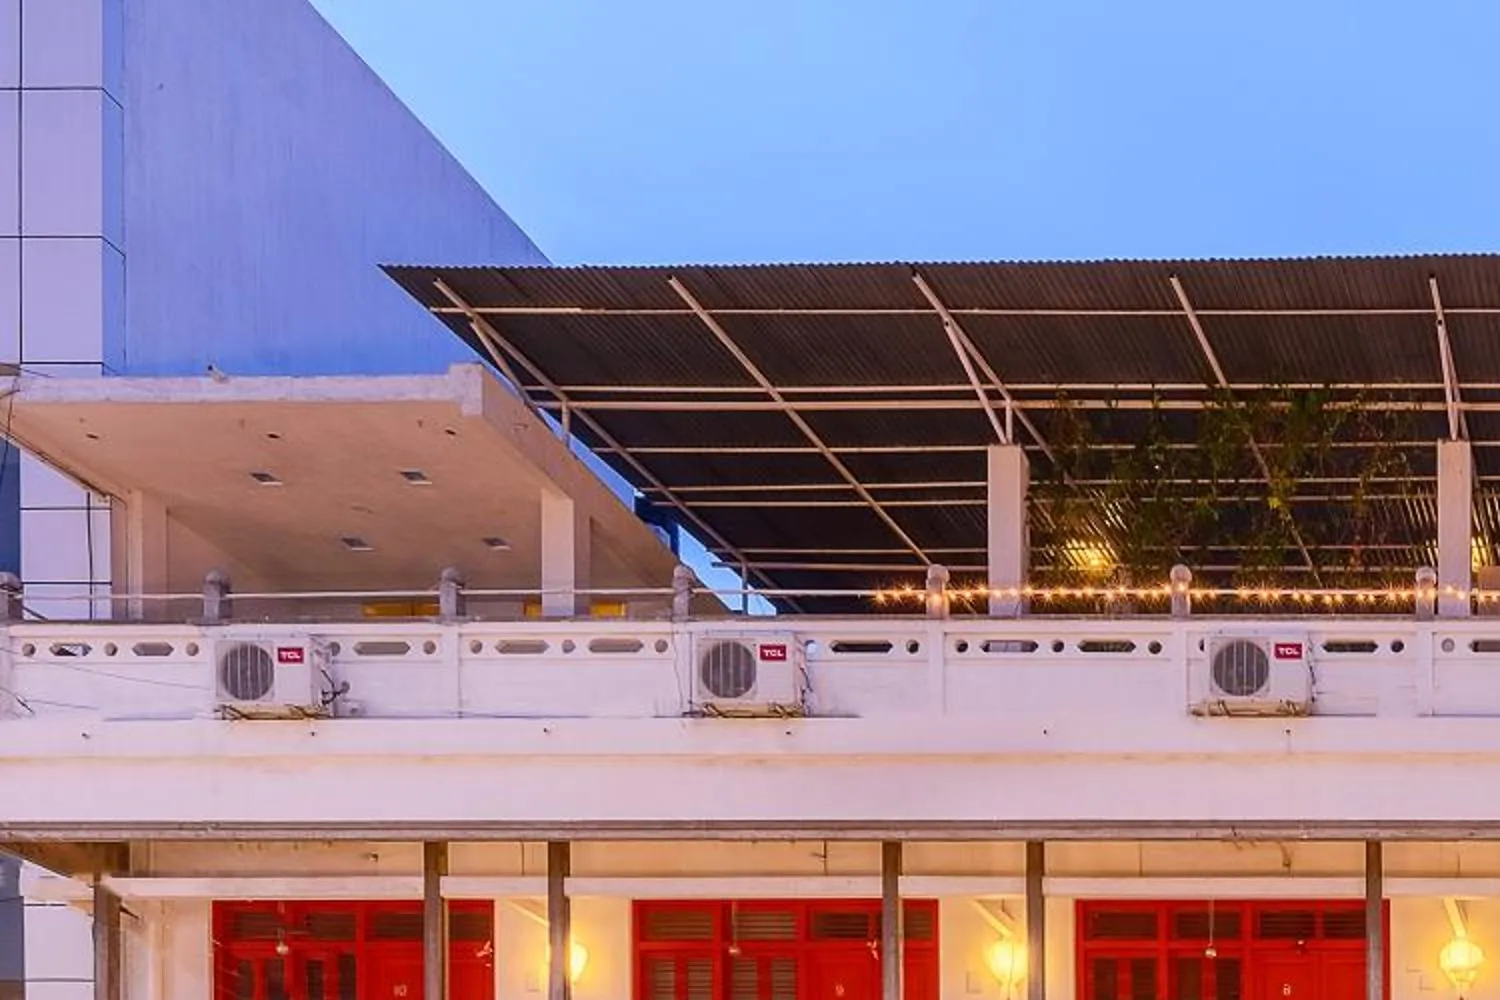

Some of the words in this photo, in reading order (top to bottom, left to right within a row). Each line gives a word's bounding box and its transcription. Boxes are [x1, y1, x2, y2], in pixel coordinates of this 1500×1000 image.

[279, 650, 302, 659] TCL
[762, 648, 784, 657] TCL
[1276, 646, 1299, 656] TCL
